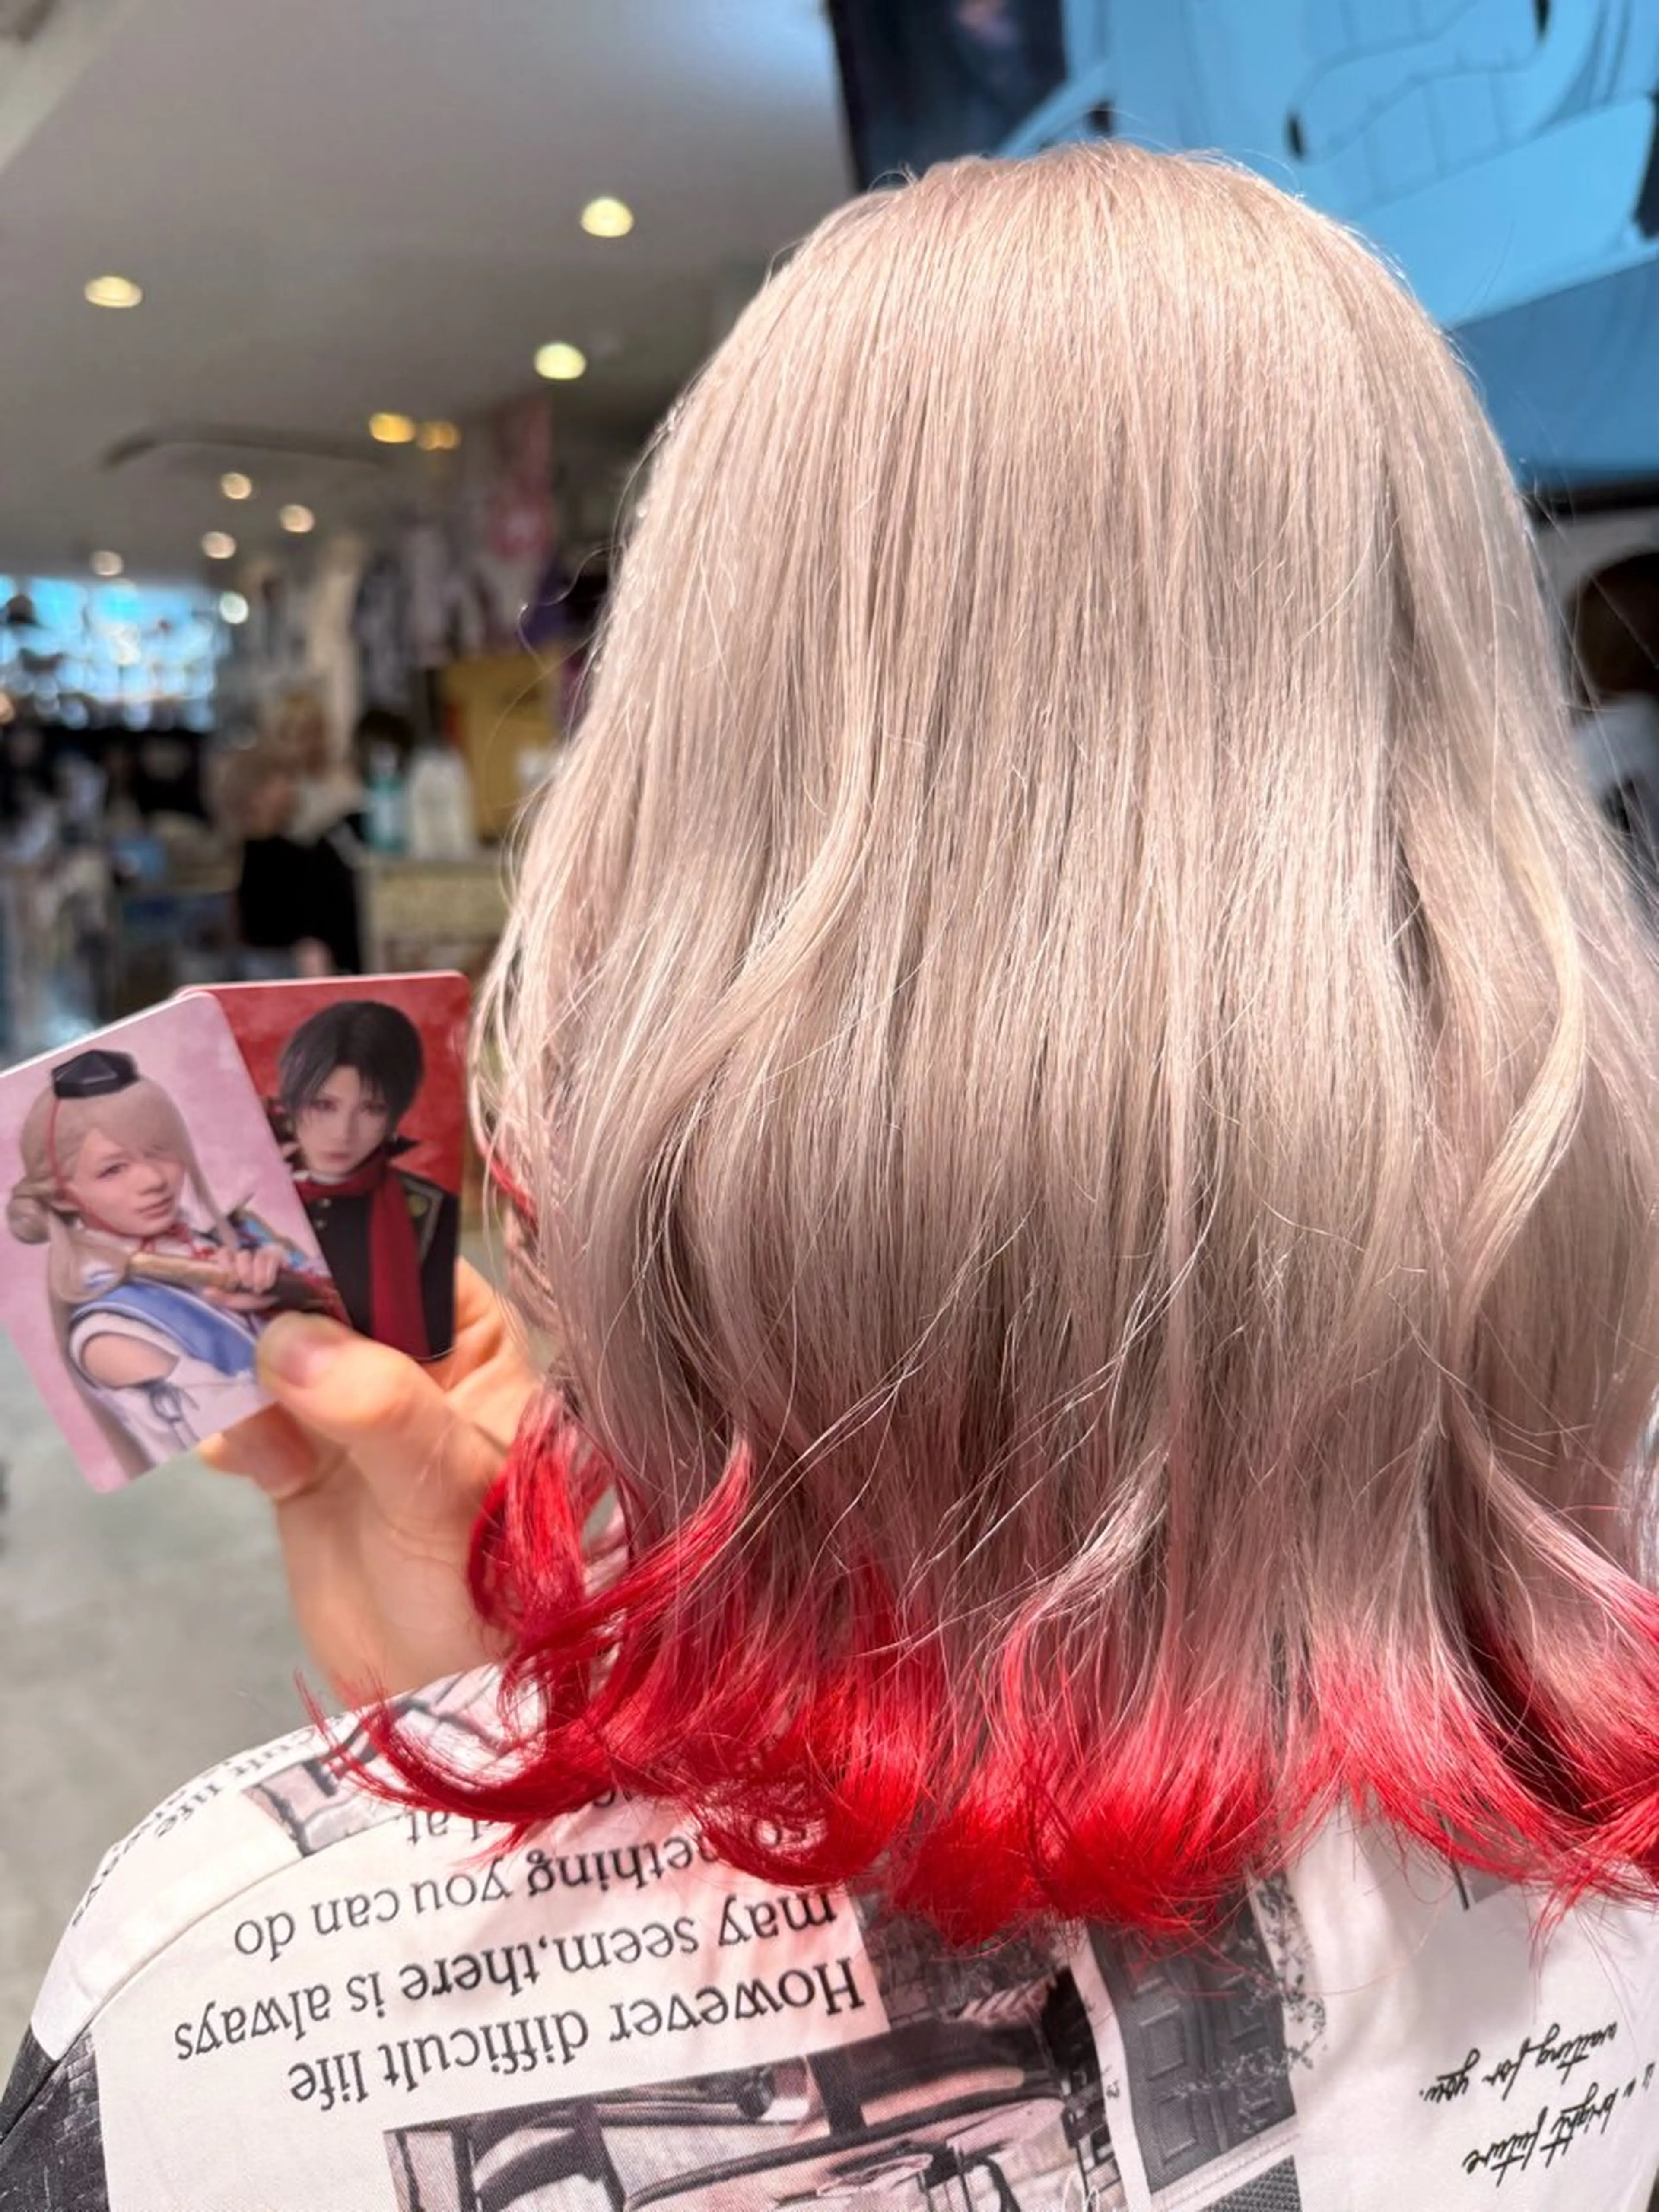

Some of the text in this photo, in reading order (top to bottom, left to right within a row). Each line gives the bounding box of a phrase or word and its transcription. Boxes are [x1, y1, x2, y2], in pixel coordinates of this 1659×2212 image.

[311, 1889, 400, 1934] can
[410, 1856, 513, 1914] you
[234, 1912, 296, 1962] do
[718, 1890, 837, 1947] may
[174, 1985, 332, 2060] always
[347, 1971, 385, 2018] is
[287, 1957, 866, 2110] However difficult life
[1532, 2023, 1617, 2085] waiting
[1482, 2037, 1531, 2100] for
[1462, 2106, 1548, 2187] future
[1540, 2082, 1618, 2167] bright
